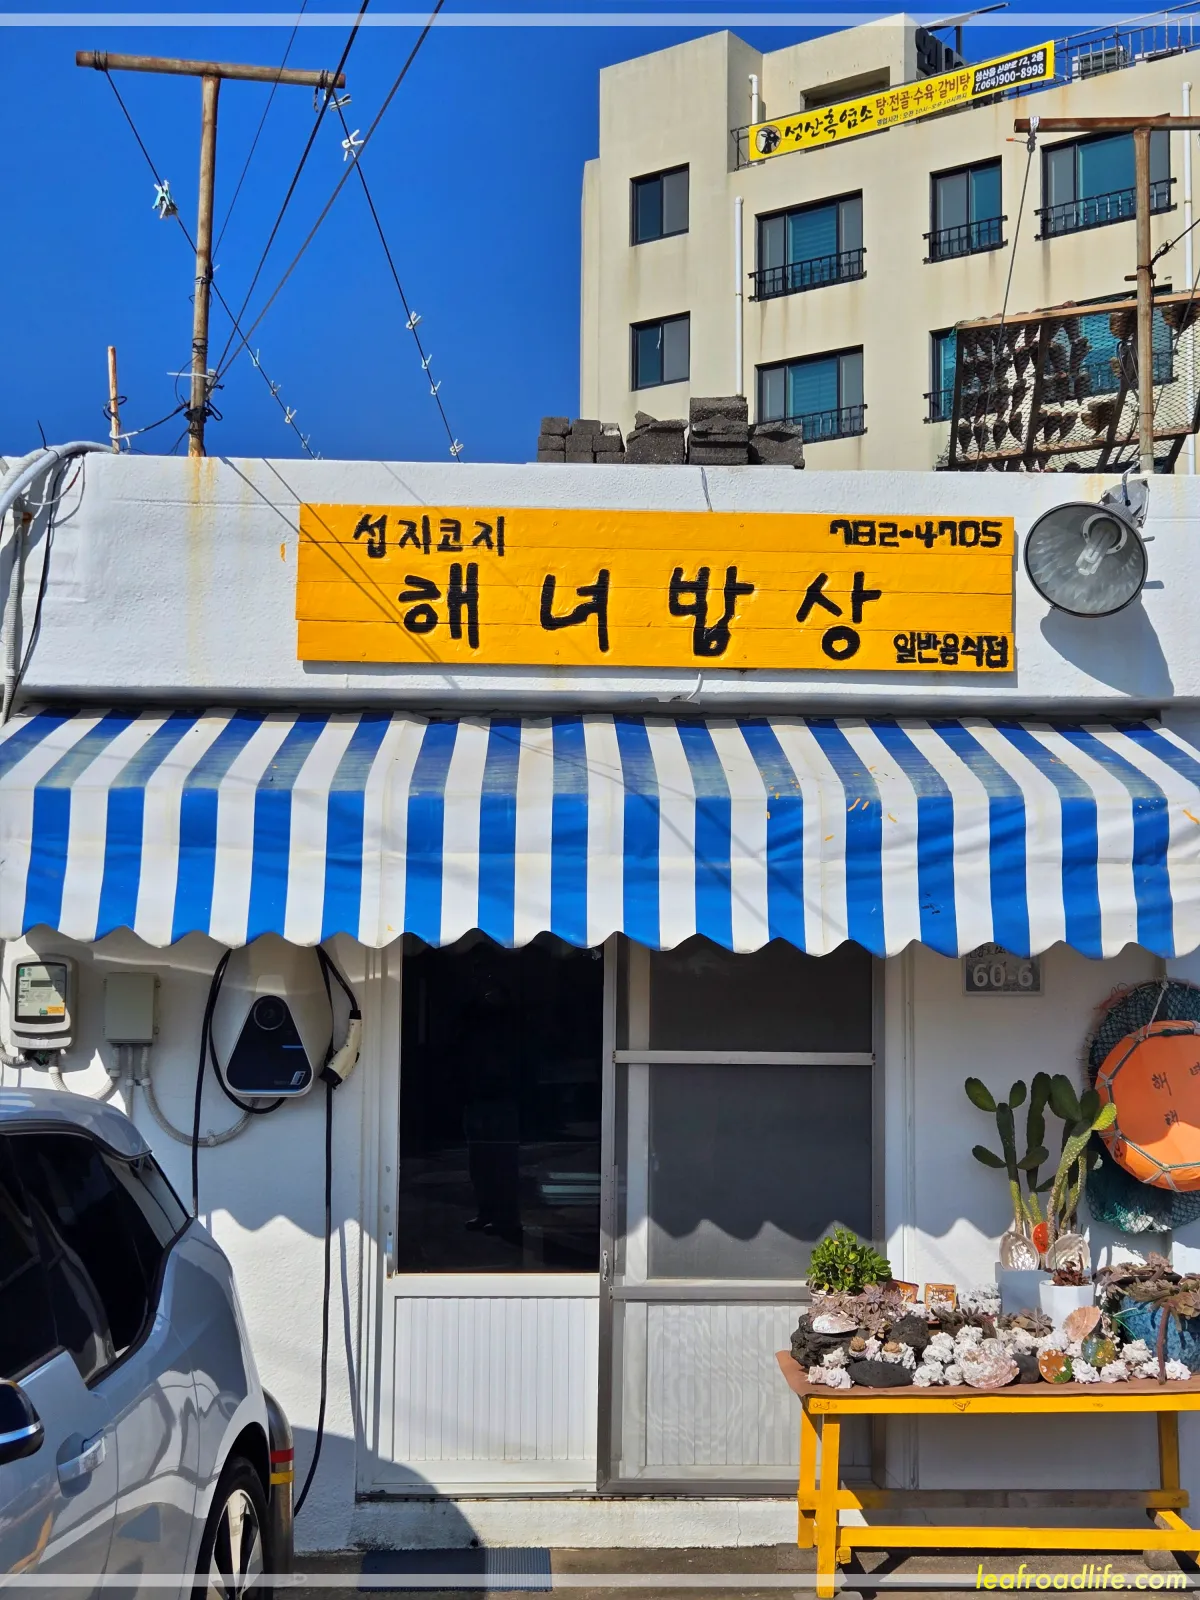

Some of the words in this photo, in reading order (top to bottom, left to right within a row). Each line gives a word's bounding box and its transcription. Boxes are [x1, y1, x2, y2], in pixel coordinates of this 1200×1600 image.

[1031, 51, 1044, 62] 2층
[975, 63, 1044, 92] T.064)900-8998
[785, 106, 874, 142] 성산흑염소
[353, 513, 506, 558] 섭지코지
[829, 518, 1003, 549] 782-4705
[893, 632, 1009, 668] 일반음식점
[972, 963, 1034, 987] 60-6
